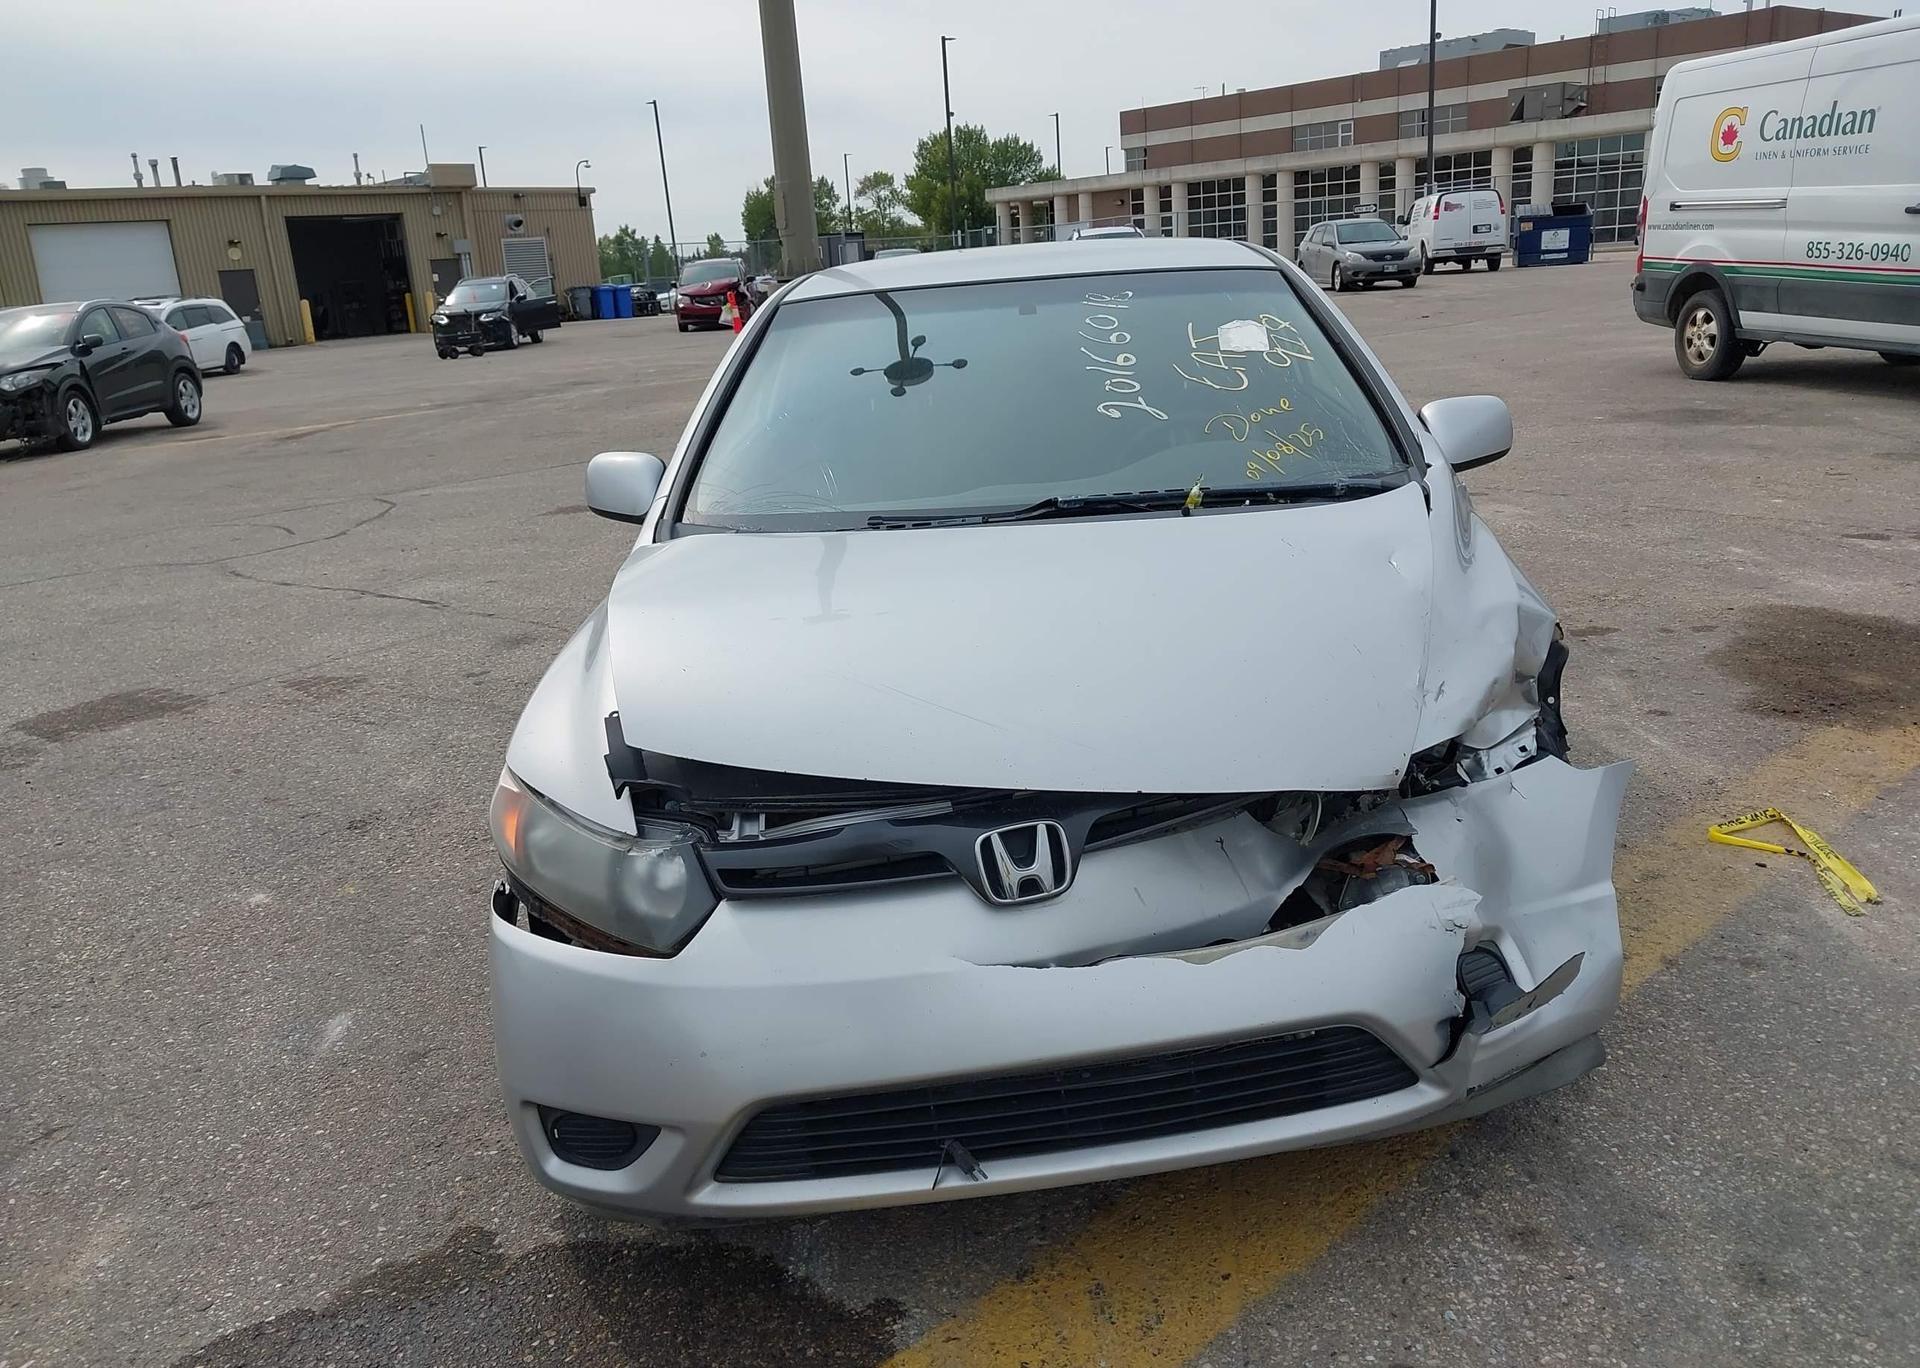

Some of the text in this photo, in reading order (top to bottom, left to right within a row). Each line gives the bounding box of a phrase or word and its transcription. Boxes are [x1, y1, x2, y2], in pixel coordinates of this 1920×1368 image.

[1759, 100, 1877, 142] Canadian
[1755, 150, 1778, 160] LINEN
[1789, 146, 1830, 159] UNIFORM
[1832, 143, 1871, 155] SERVICE
[1647, 221, 1715, 231] www.canadianlinen.com
[1806, 240, 1912, 262] 855-326-0940
[1204, 397, 1295, 442] Done
